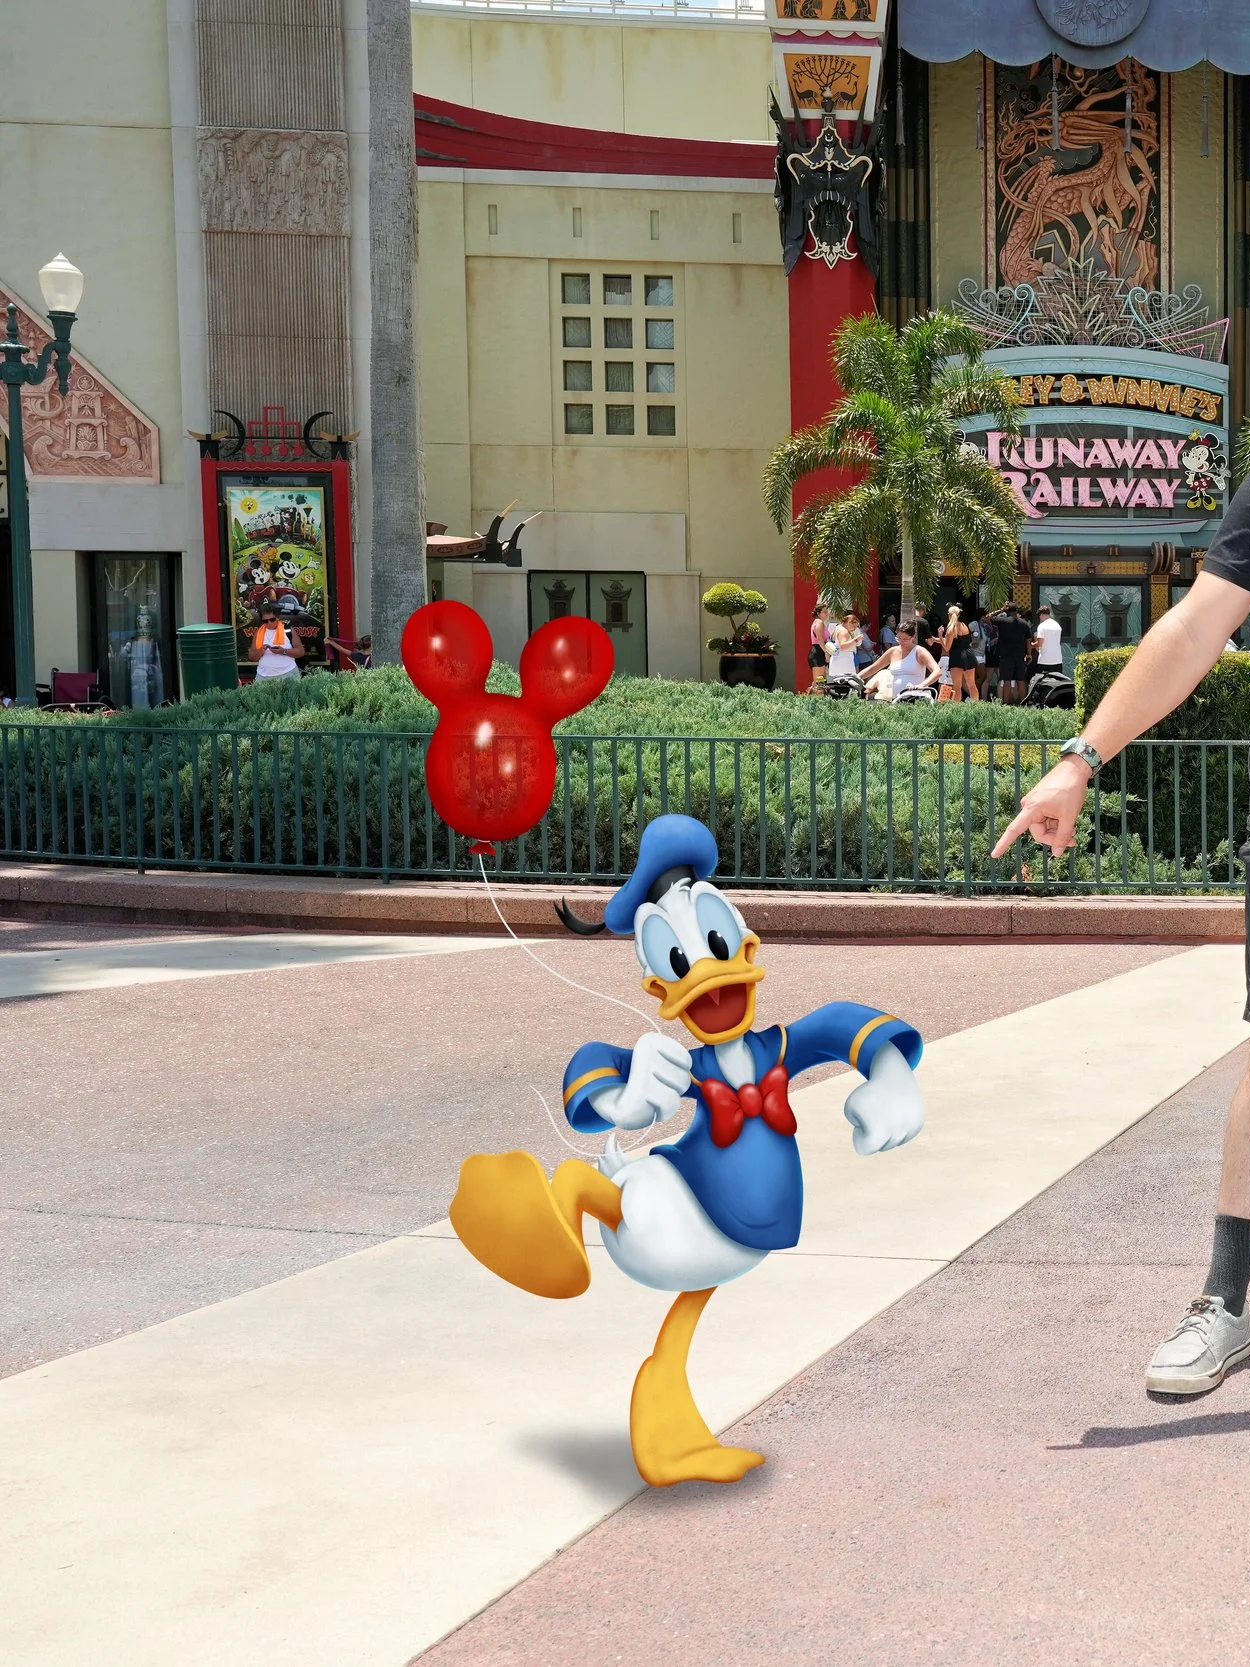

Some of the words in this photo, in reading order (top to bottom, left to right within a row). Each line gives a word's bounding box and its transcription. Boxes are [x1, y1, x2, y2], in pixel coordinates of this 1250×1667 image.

[1060, 374, 1086, 403] &
[1085, 375, 1222, 421] MINNIE'S
[986, 431, 1187, 470] RUNAWAY
[1001, 471, 1182, 519] RAILWAY
[292, 626, 320, 637] OUSE
